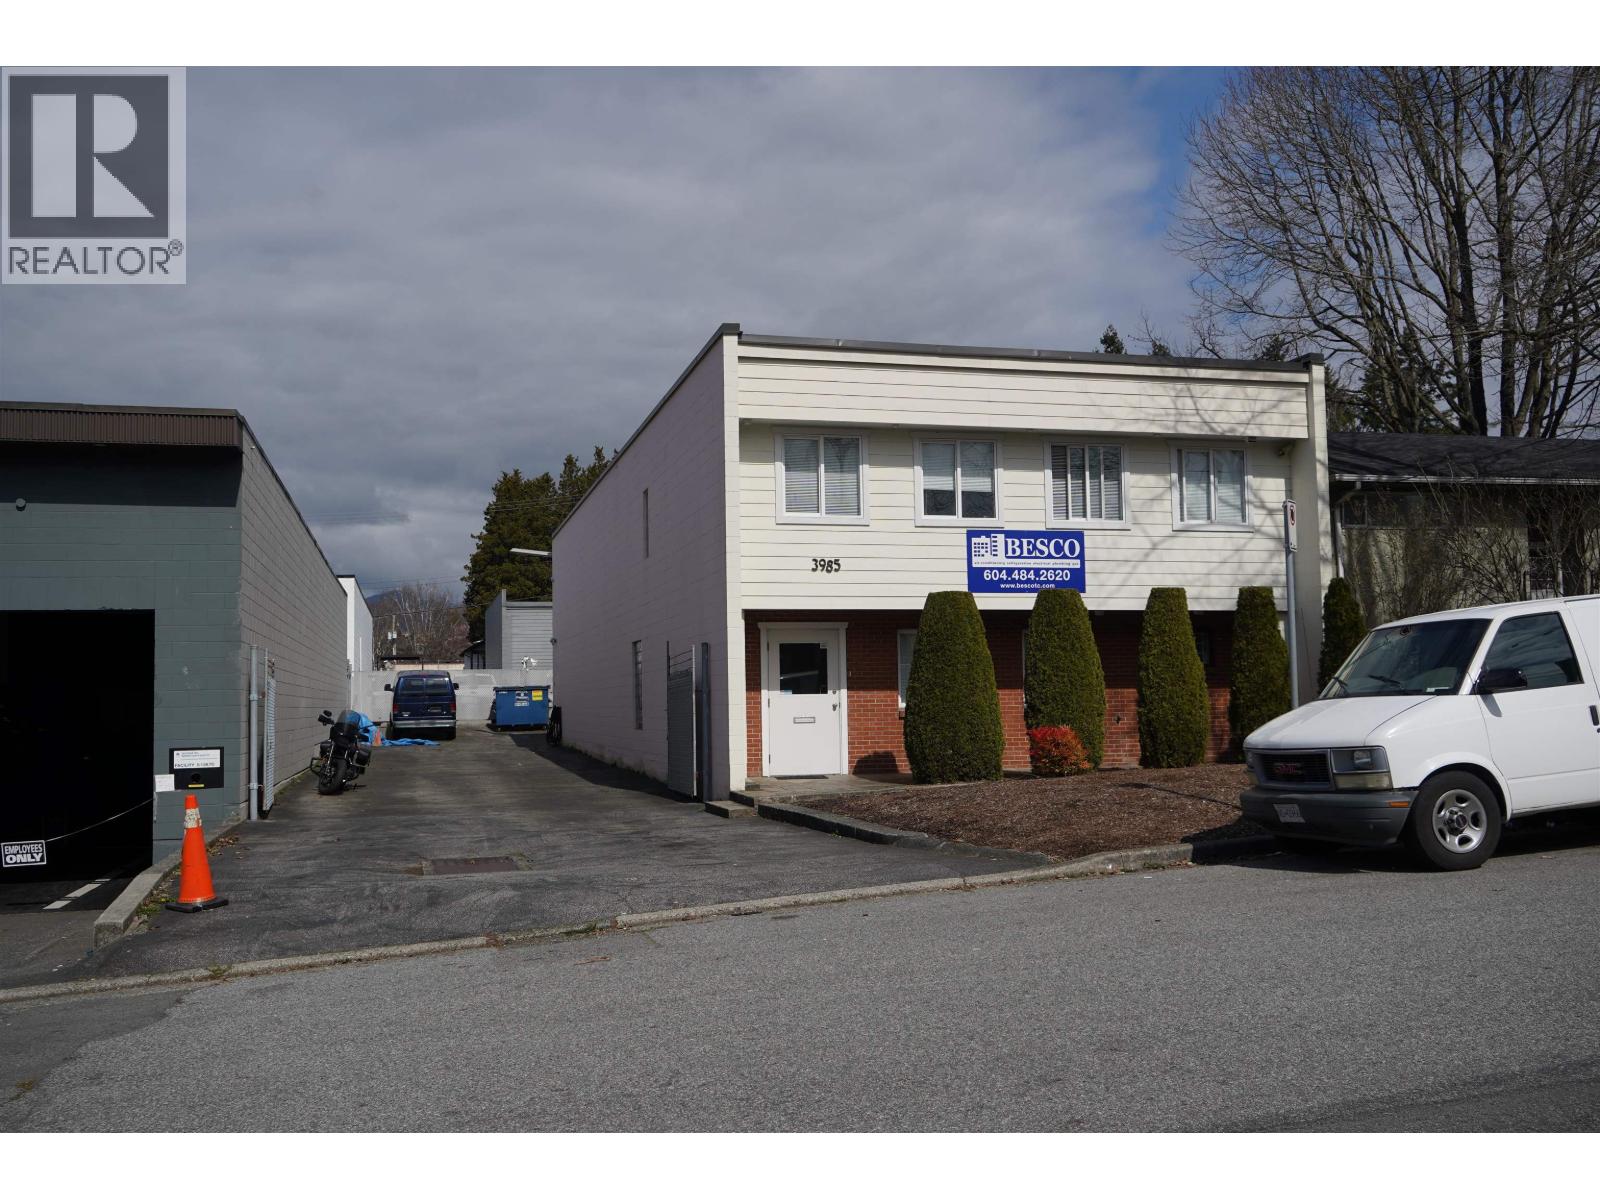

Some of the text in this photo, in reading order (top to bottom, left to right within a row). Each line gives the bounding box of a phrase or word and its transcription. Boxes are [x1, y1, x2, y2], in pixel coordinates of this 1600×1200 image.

[1005, 538, 1081, 558] BESCO
[811, 558, 841, 573] 3985
[983, 569, 1071, 581] 604.484.2620
[4, 844, 43, 854] EMPLOYEES
[5, 853, 43, 864] ONLY
